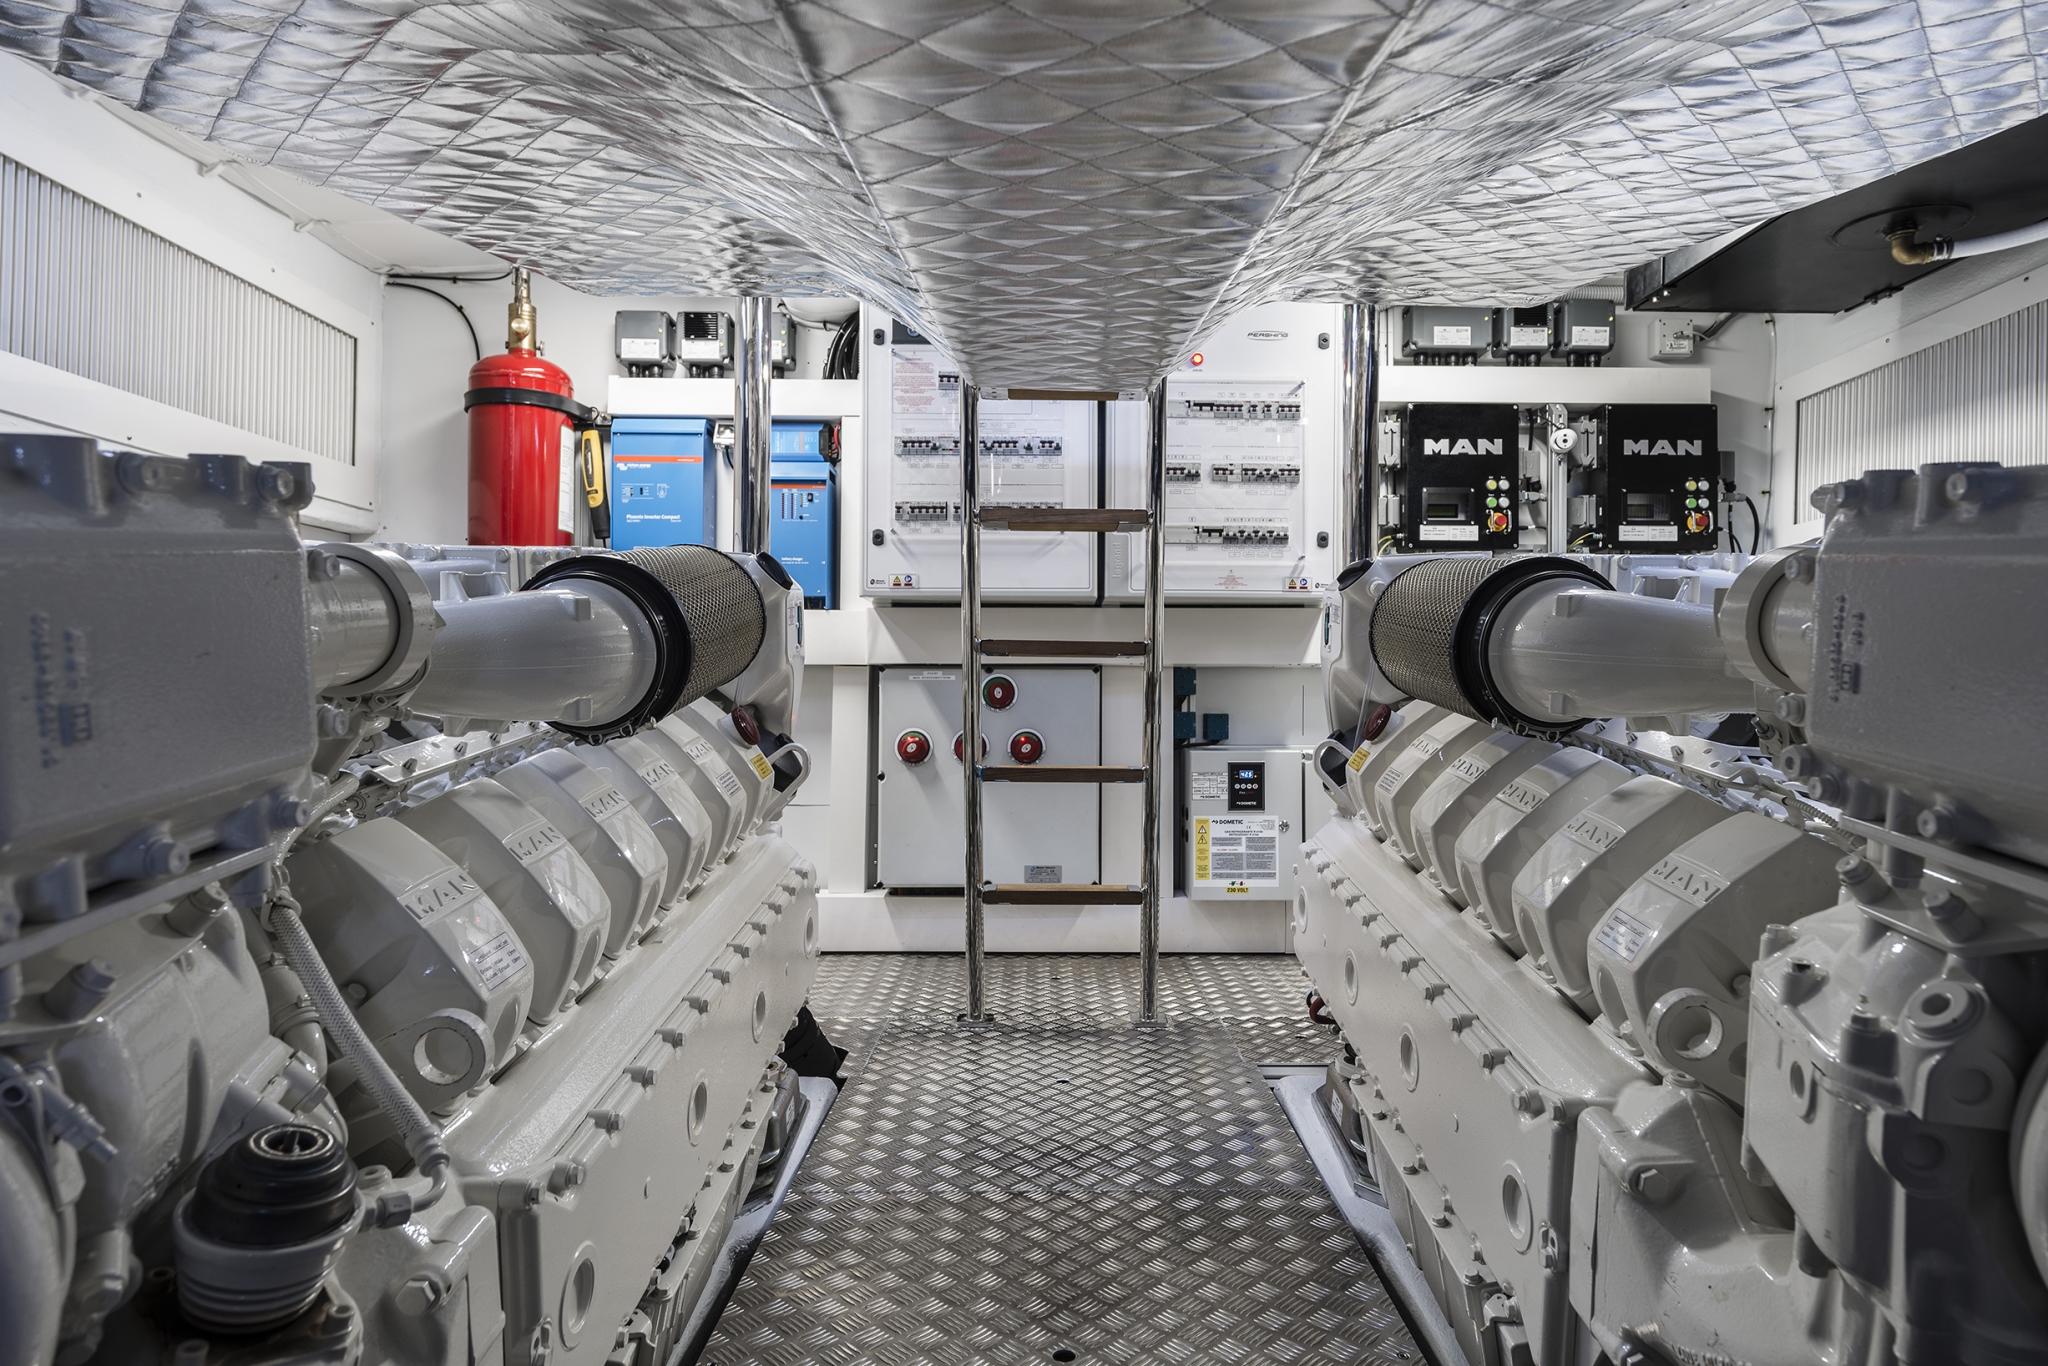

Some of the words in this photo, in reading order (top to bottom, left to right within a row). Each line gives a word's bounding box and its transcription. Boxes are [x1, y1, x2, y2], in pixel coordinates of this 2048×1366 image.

[1423, 438, 1503, 455] MAN
[1623, 439, 1702, 455] MAN
[686, 741, 714, 761] MAN
[1410, 739, 1439, 756] MAN
[641, 762, 675, 786] MAN
[1452, 758, 1486, 779] MAN
[584, 790, 625, 818] MAN
[1502, 783, 1543, 809] MAN
[509, 826, 561, 861] MAN
[1567, 818, 1619, 849] MAN
[1650, 860, 1721, 903] MAN
[405, 873, 476, 920] MAN
